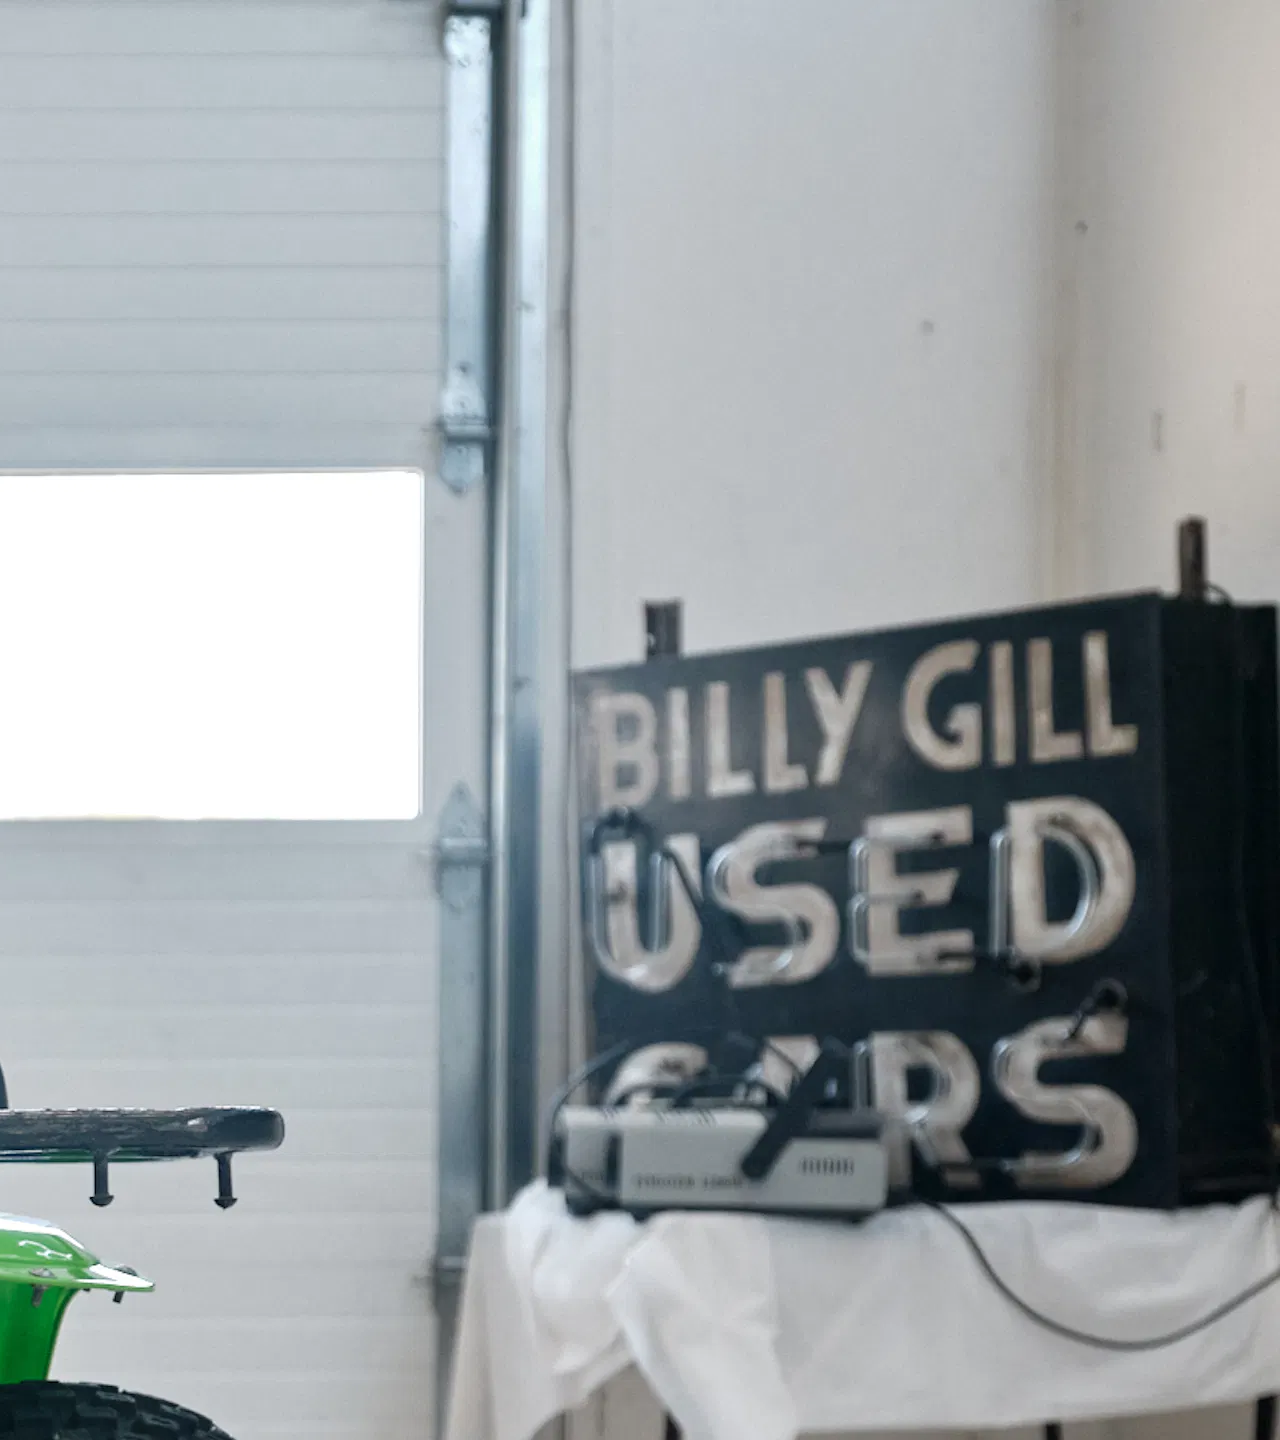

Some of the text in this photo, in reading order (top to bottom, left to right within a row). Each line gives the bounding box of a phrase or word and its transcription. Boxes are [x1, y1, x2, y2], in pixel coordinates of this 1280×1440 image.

[592, 631, 1138, 811] BILLY GILL
[591, 796, 1138, 993] USED
[604, 1014, 1138, 1191] RS
